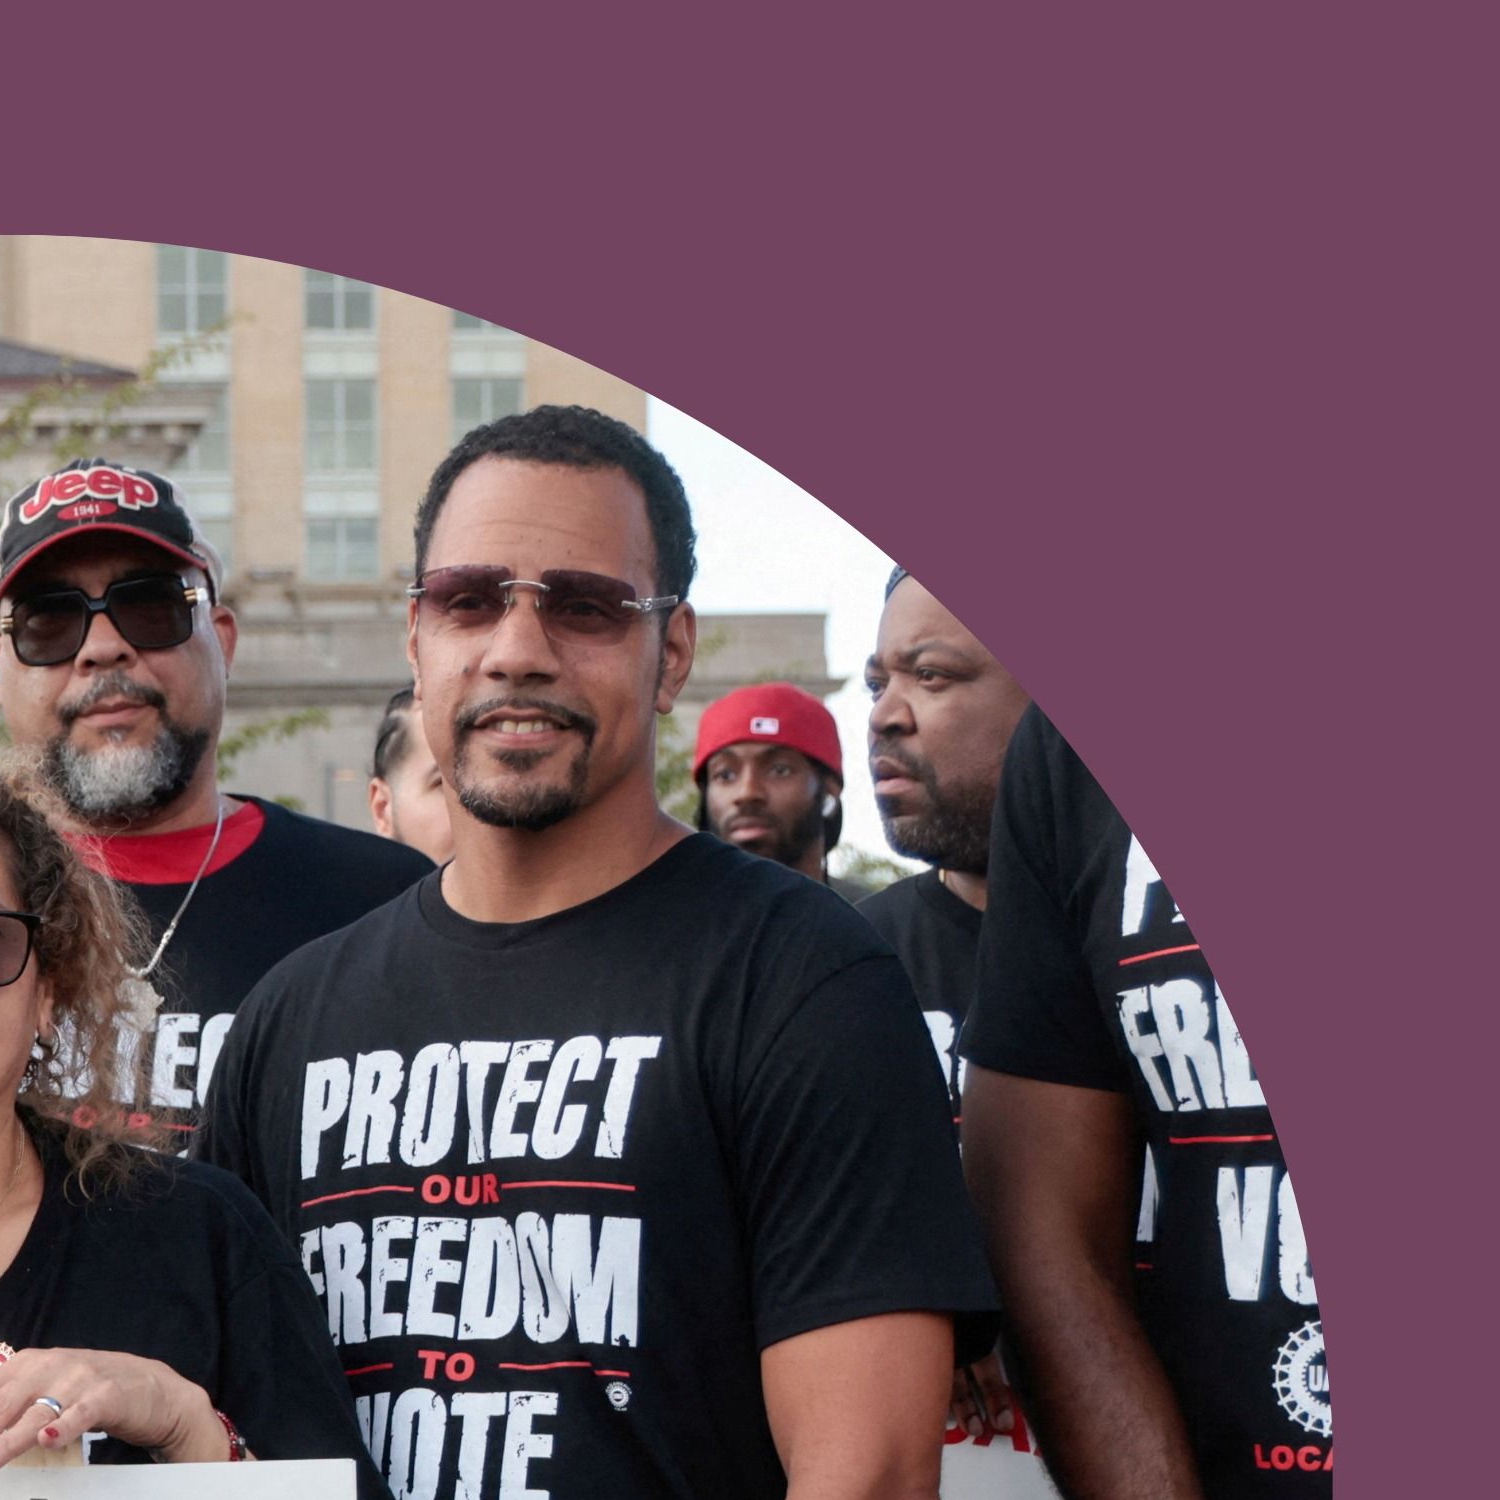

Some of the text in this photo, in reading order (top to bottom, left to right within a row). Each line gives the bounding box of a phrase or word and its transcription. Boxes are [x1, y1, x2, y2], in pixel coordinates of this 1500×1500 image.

[19, 466, 159, 524] Jeep
[73, 505, 101, 517] 1941
[301, 1035, 662, 1180] PROTECT
[421, 1174, 500, 1206] OUR
[300, 1211, 642, 1348] FREEDOM
[418, 1350, 476, 1382] TO
